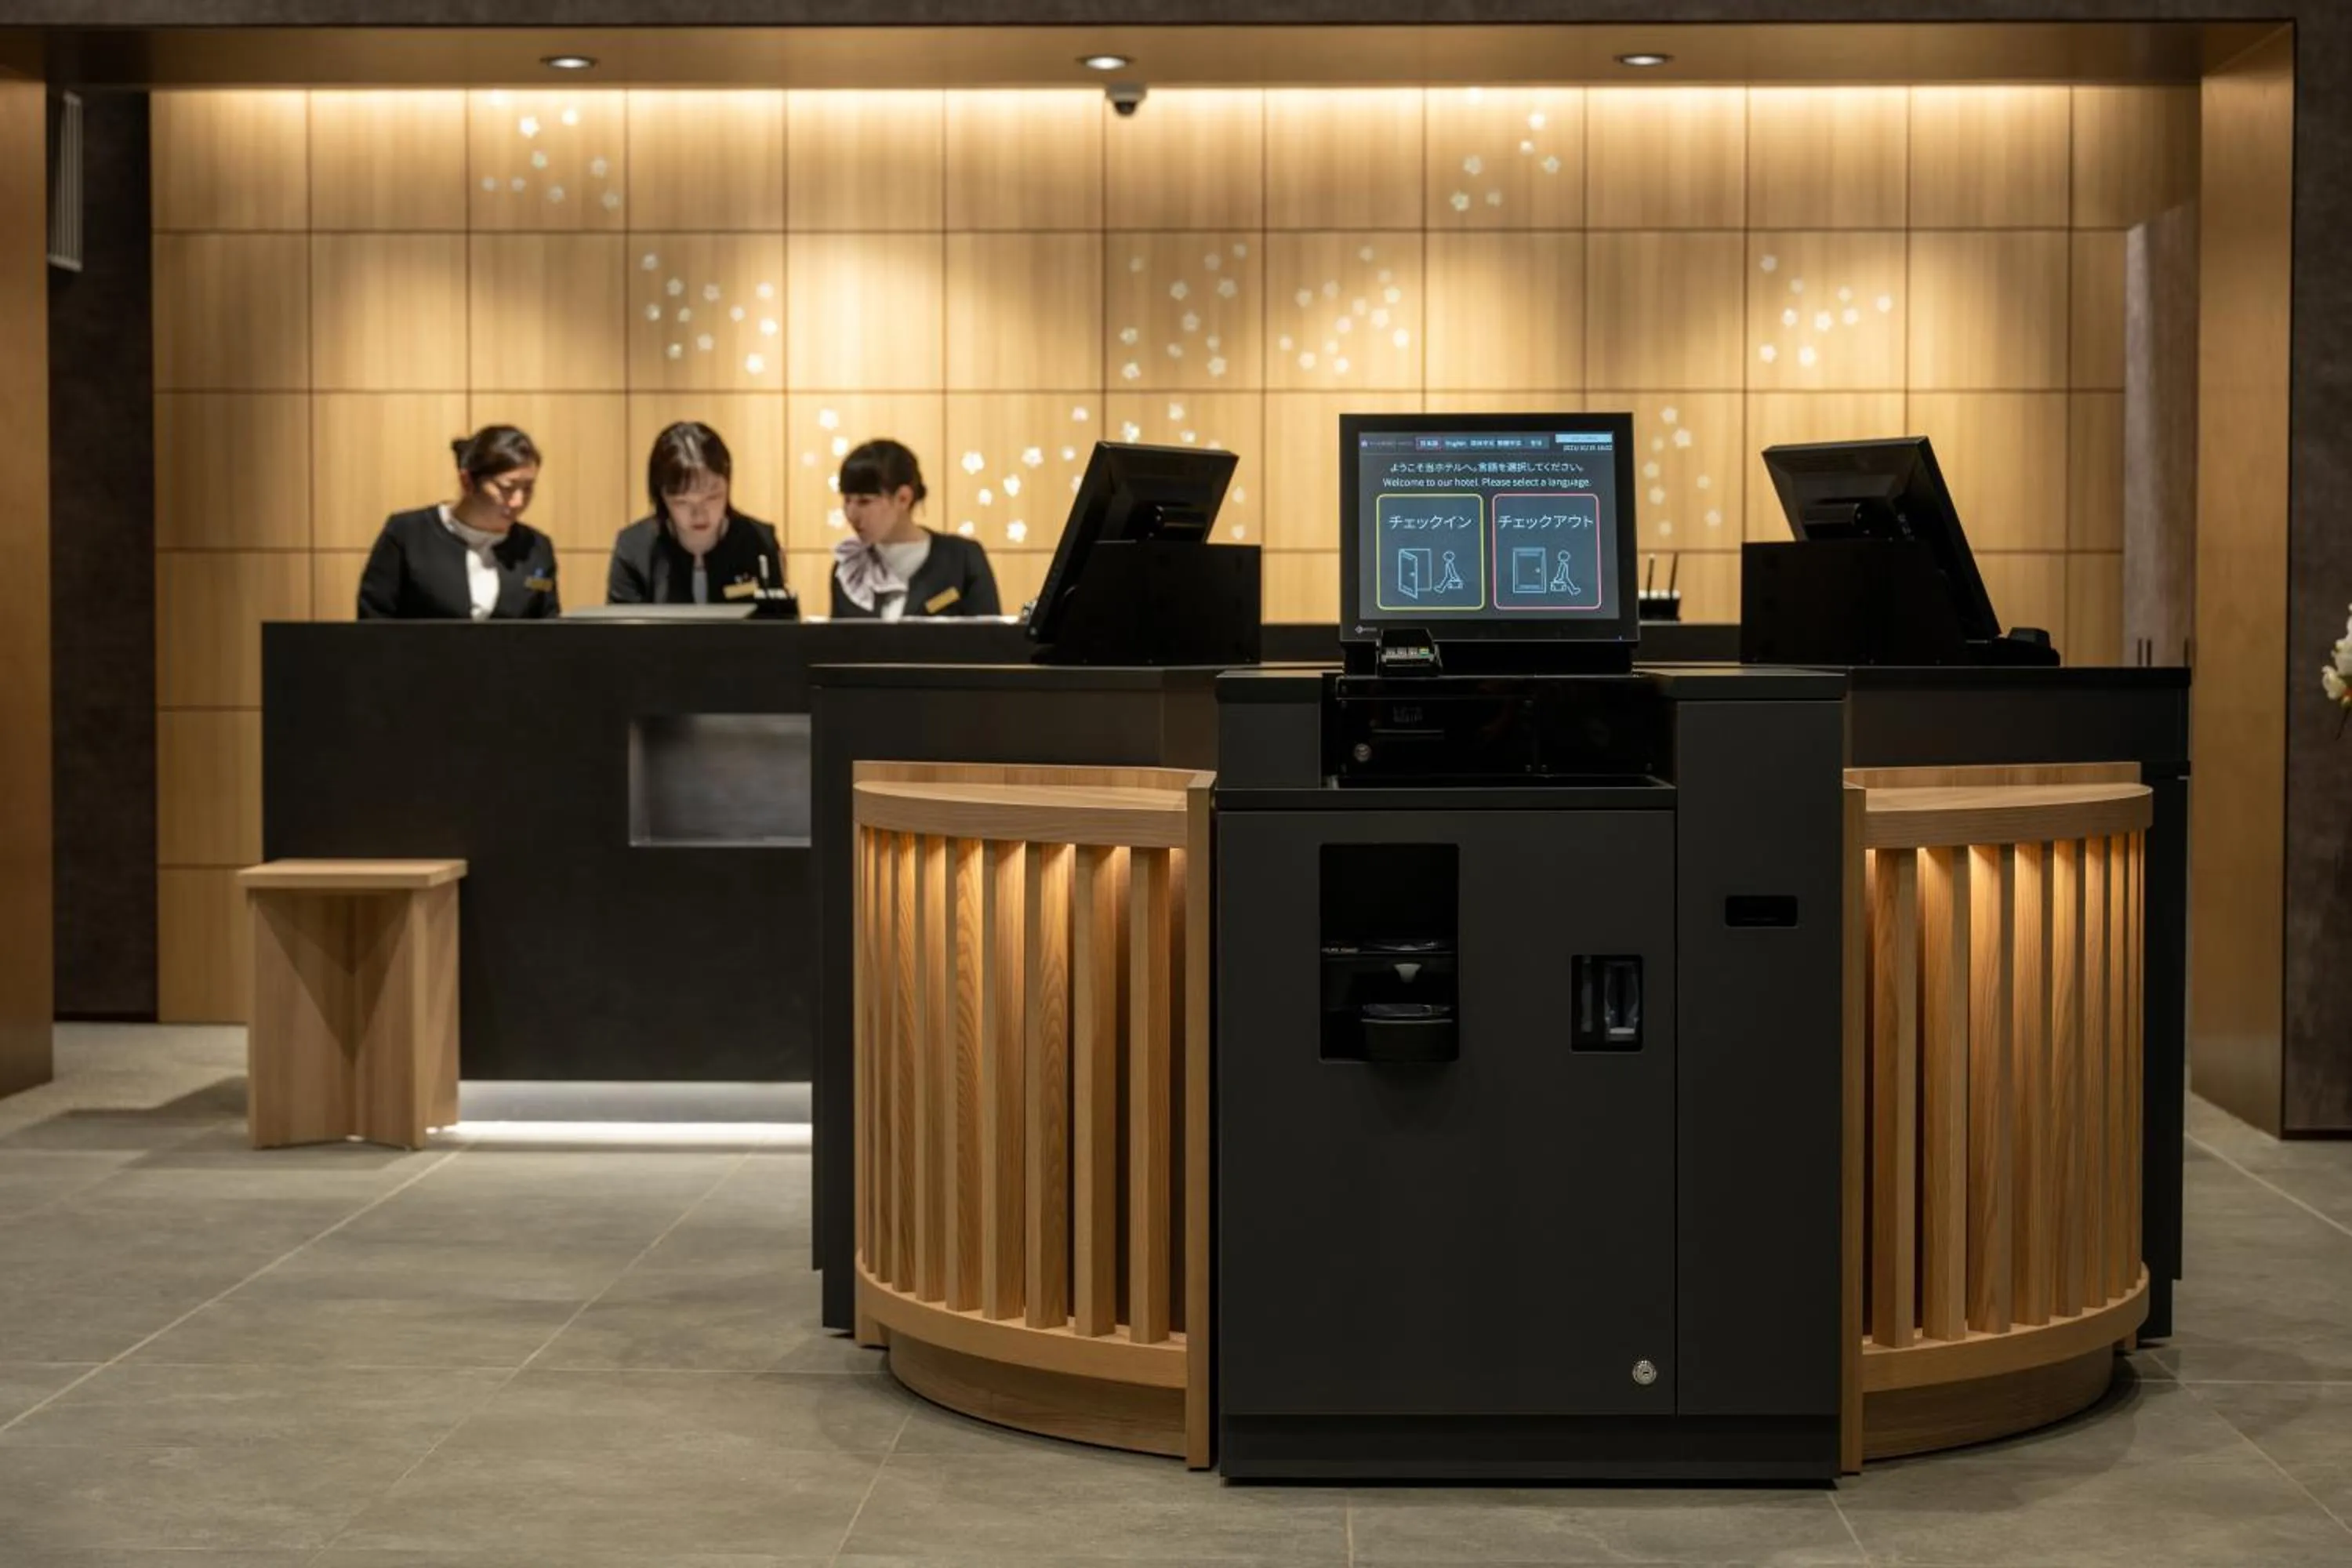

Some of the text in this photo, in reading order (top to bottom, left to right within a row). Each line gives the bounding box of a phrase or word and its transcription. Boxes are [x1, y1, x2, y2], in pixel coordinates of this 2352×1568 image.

[1382, 477, 1425, 487] Welcome
[1426, 477, 1436, 487] to
[1481, 477, 1512, 487] Please
[1512, 477, 1539, 487] select
[1388, 514, 1472, 529] チェックイン
[1498, 514, 1594, 529] チェックアウト
